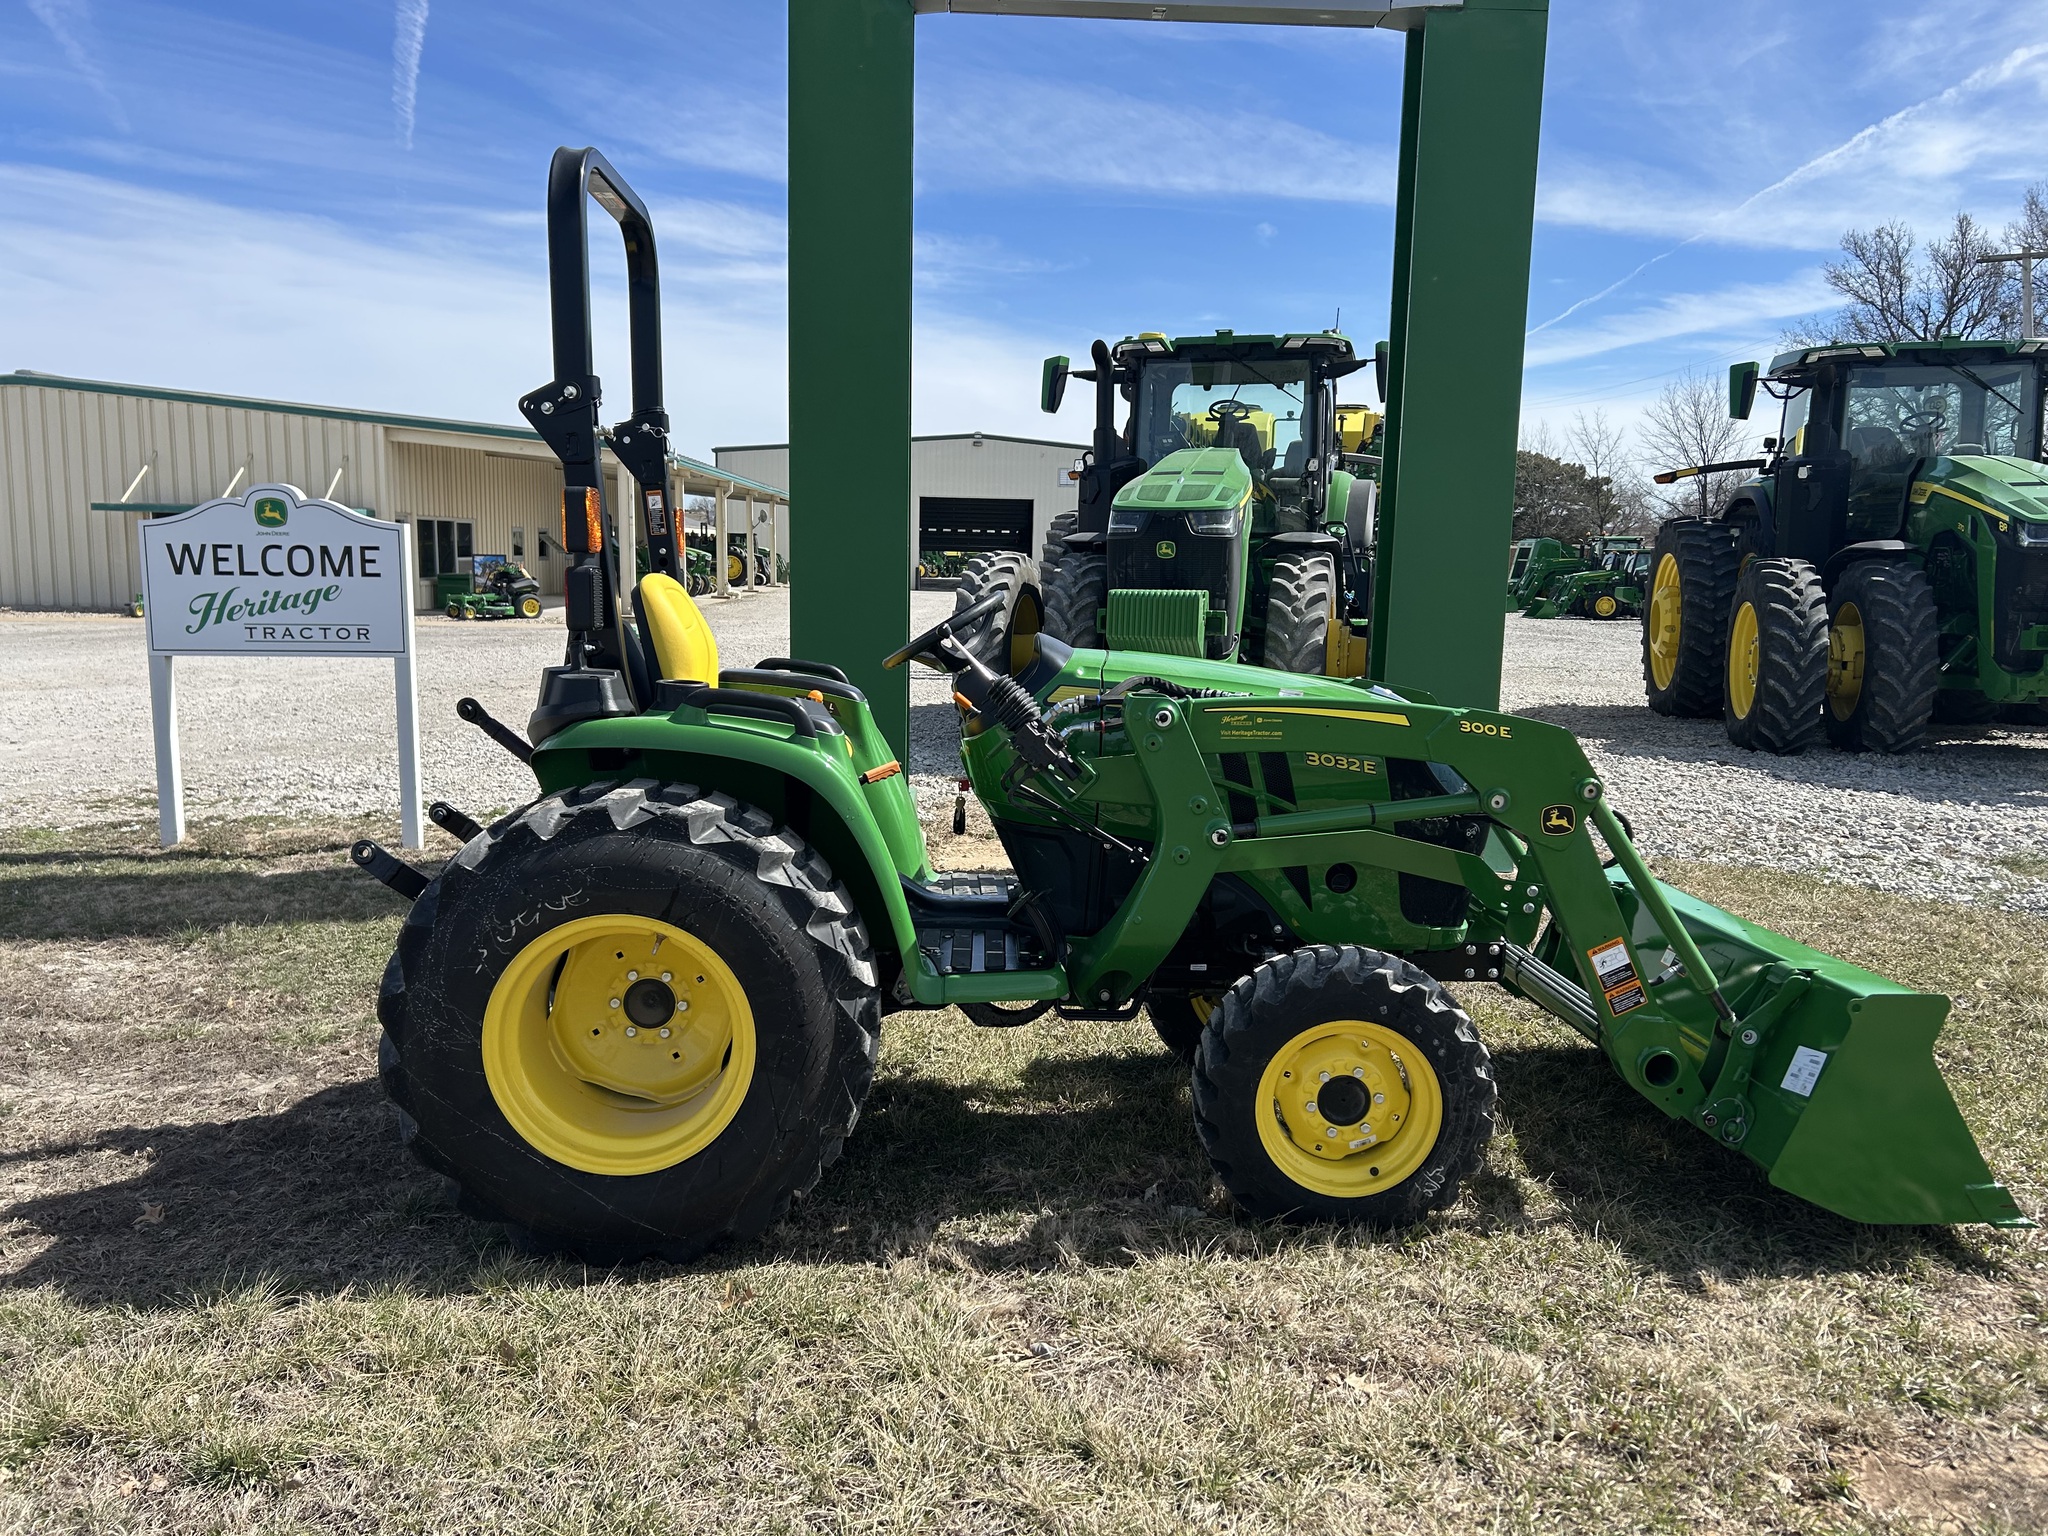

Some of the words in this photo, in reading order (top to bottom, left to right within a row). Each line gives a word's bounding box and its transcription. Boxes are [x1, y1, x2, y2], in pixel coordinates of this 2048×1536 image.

[166, 543, 382, 578] WELCOME
[185, 584, 343, 635] Heritage
[244, 626, 371, 641] TRACTOR
[1597, 940, 1620, 952] WARNING
[1616, 982, 1638, 994] WARNING
